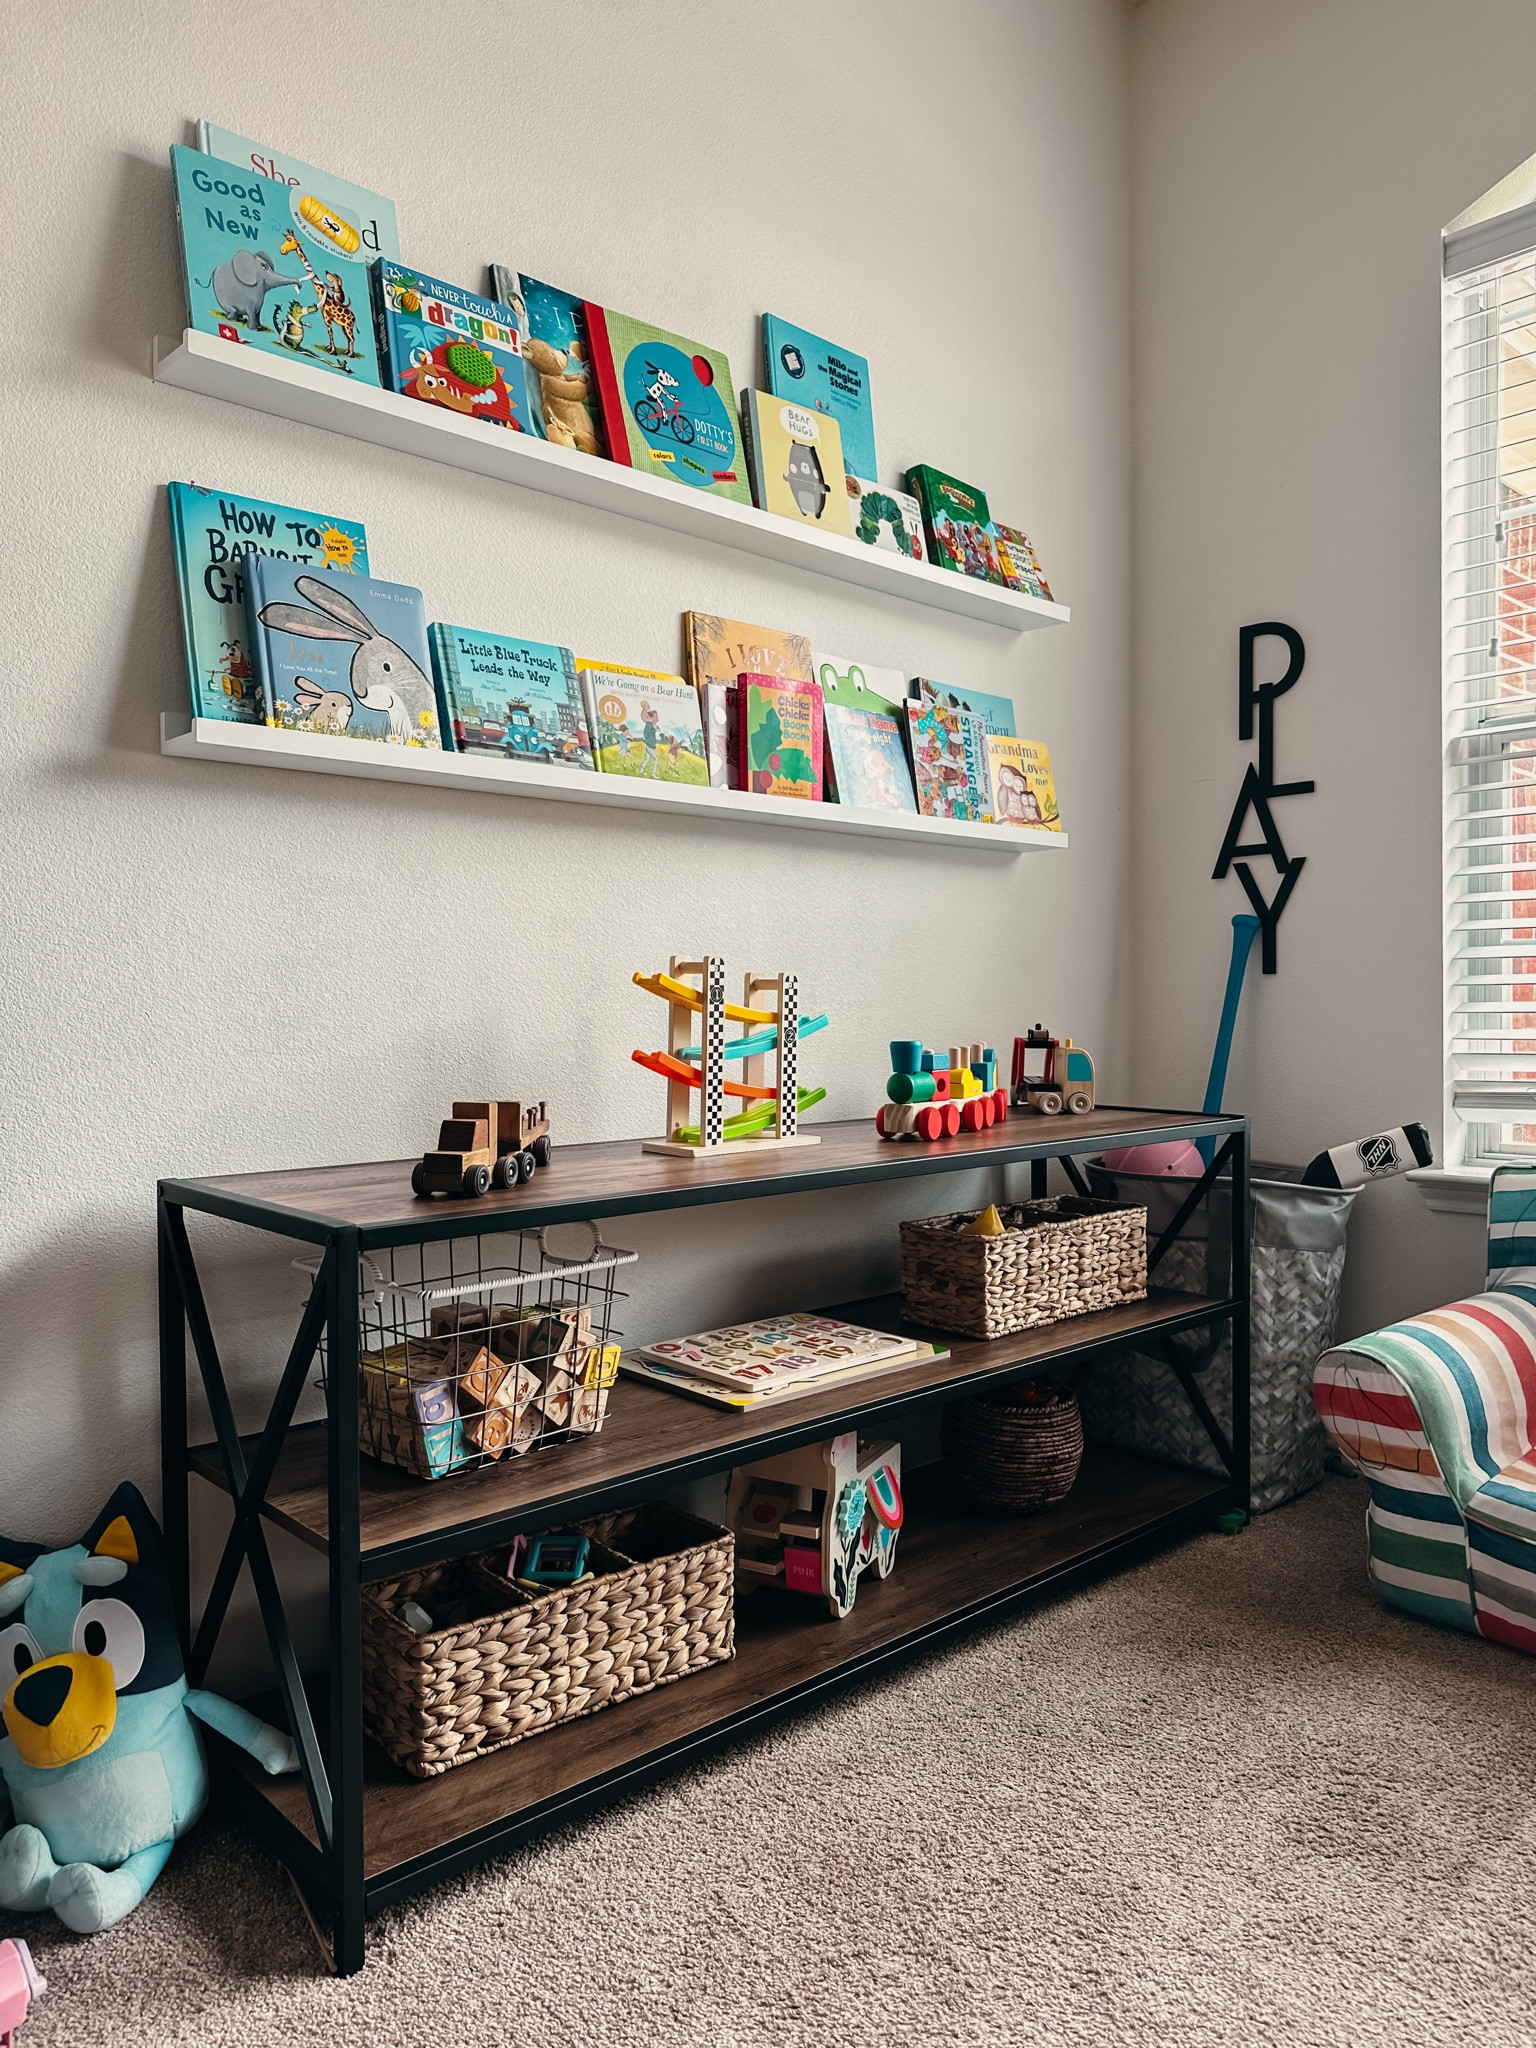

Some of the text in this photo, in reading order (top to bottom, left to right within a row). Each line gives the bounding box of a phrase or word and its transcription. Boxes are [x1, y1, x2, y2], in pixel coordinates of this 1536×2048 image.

[191, 169, 266, 207] Good
[240, 204, 262, 221] as
[204, 207, 260, 241] New
[430, 283, 514, 325] NEVER touch A
[427, 302, 520, 353] dragon!
[827, 355, 847, 371] Milo
[828, 366, 862, 388] Magical
[830, 376, 859, 397] Stones
[694, 418, 734, 445] DOTTY'S
[696, 435, 714, 449] FIRST
[653, 451, 673, 461] colors
[218, 498, 321, 549] HOW TO
[369, 589, 414, 605] Emma Dodd
[458, 638, 558, 672] Little Blue Truck
[725, 643, 789, 678] I LOVE
[470, 659, 504, 676] Leads
[508, 666, 525, 680] the
[526, 670, 551, 687] Way
[593, 675, 614, 687] We're
[616, 678, 640, 693] Going
[640, 684, 650, 692] on
[656, 685, 674, 696] Bear
[675, 688, 694, 699] Hunt
[777, 695, 810, 711] Chicka
[777, 707, 811, 722] Chicka
[783, 718, 810, 731] Boom
[783, 729, 810, 742] Boom
[971, 720, 979, 748] LEARN
[987, 739, 1039, 759] Grandma
[961, 716, 981, 820] STRANGERS
[1020, 759, 1049, 776] Loves
[1211, 621, 1315, 975] PLAY
[714, 989, 721, 1000] 1
[786, 1030, 794, 1041] 2
[1366, 1140, 1387, 1165] NHL
[766, 1318, 796, 1329] 5
[794, 1312, 818, 1323] 6
[811, 1320, 849, 1332] 12
[751, 1333, 790, 1345] 10
[834, 1328, 873, 1340] 16
[654, 1343, 683, 1353] 0
[727, 1340, 755, 1350] 9
[796, 1336, 835, 1348] 15
[676, 1350, 704, 1361] 7
[704, 1345, 736, 1356] 8
[754, 1346, 795, 1359] 14
[818, 1345, 855, 1359] 19
[705, 1357, 748, 1369] 13
[775, 1355, 817, 1369] 18
[734, 1364, 775, 1378] 17
[793, 1564, 816, 1578] PINK
